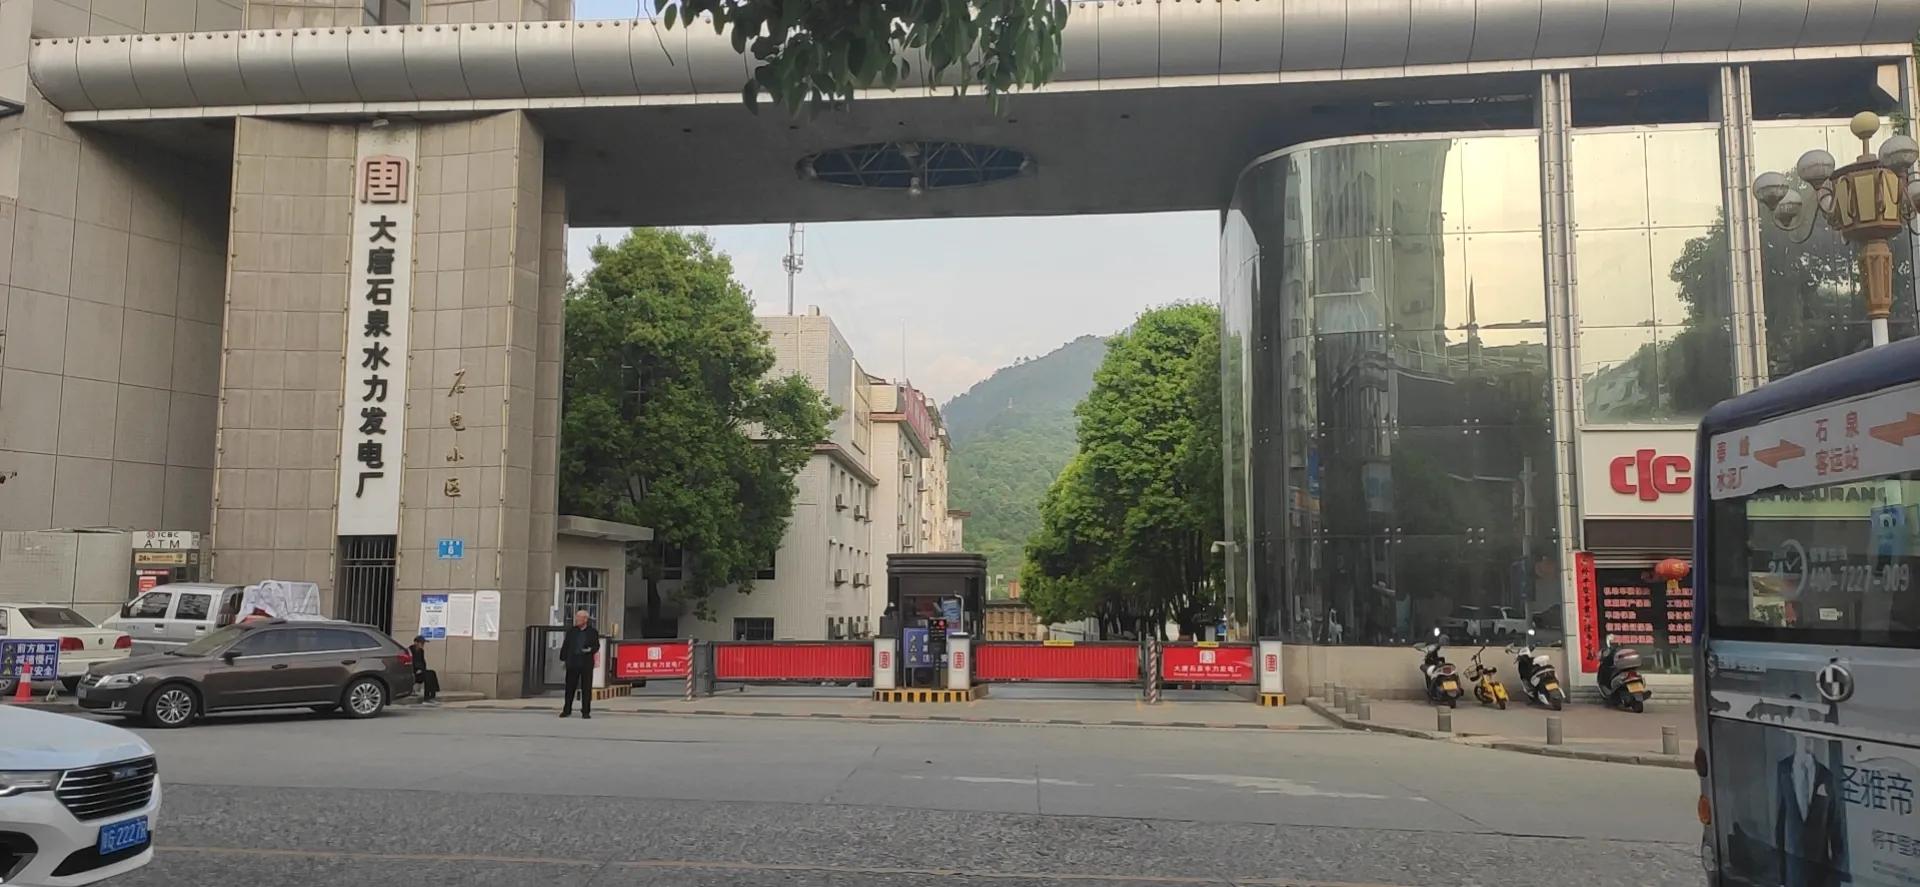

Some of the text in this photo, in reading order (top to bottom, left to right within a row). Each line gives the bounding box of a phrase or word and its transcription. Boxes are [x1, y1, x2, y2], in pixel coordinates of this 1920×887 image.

[356, 215, 397, 498] 大唐石泉水力发电厂
[444, 368, 467, 498] 石电小区
[1815, 447, 1860, 477] 客运站
[144, 539, 180, 549] ATM
[17, 643, 56, 654] 前方施工
[15, 666, 53, 676] 注安全
[1841, 764, 1914, 816] 圣雅帝
